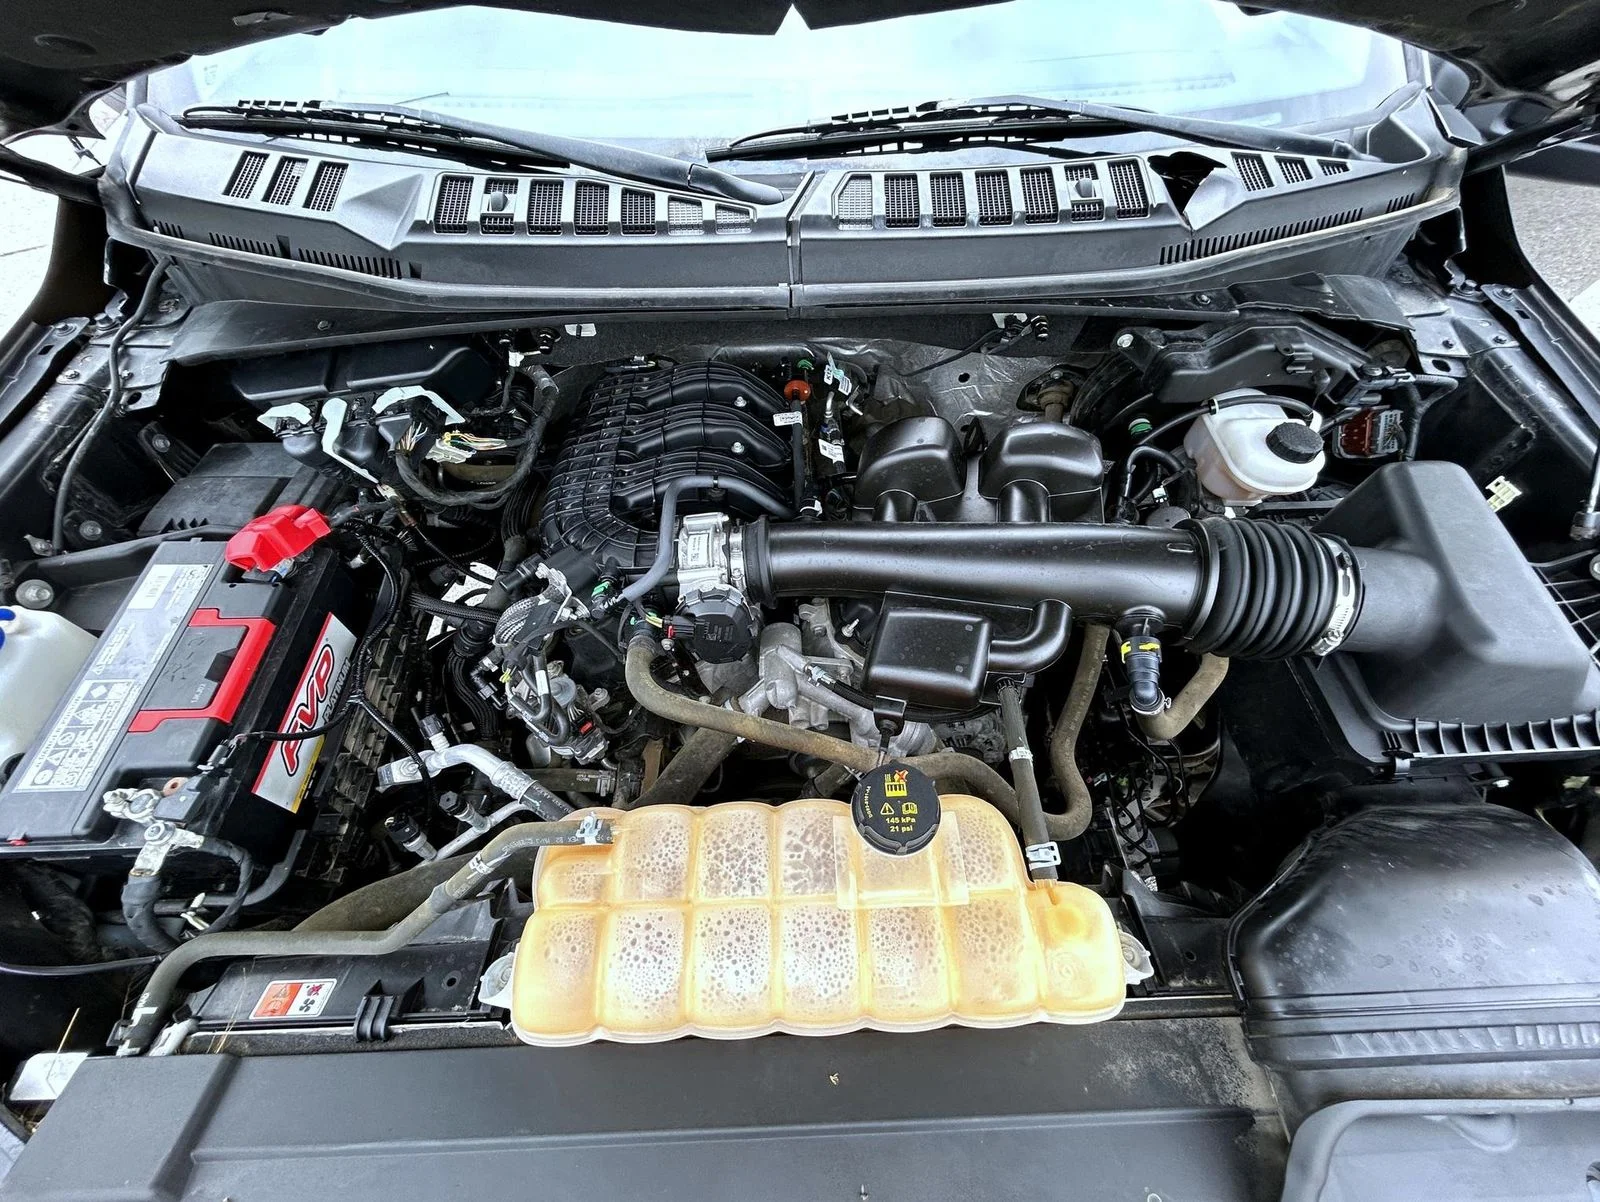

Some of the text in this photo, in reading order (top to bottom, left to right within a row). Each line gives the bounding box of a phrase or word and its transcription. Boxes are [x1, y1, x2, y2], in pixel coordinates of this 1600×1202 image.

[281, 643, 334, 776] AVP
[322, 656, 351, 726] PLATINUM
[901, 825, 913, 833] psi
